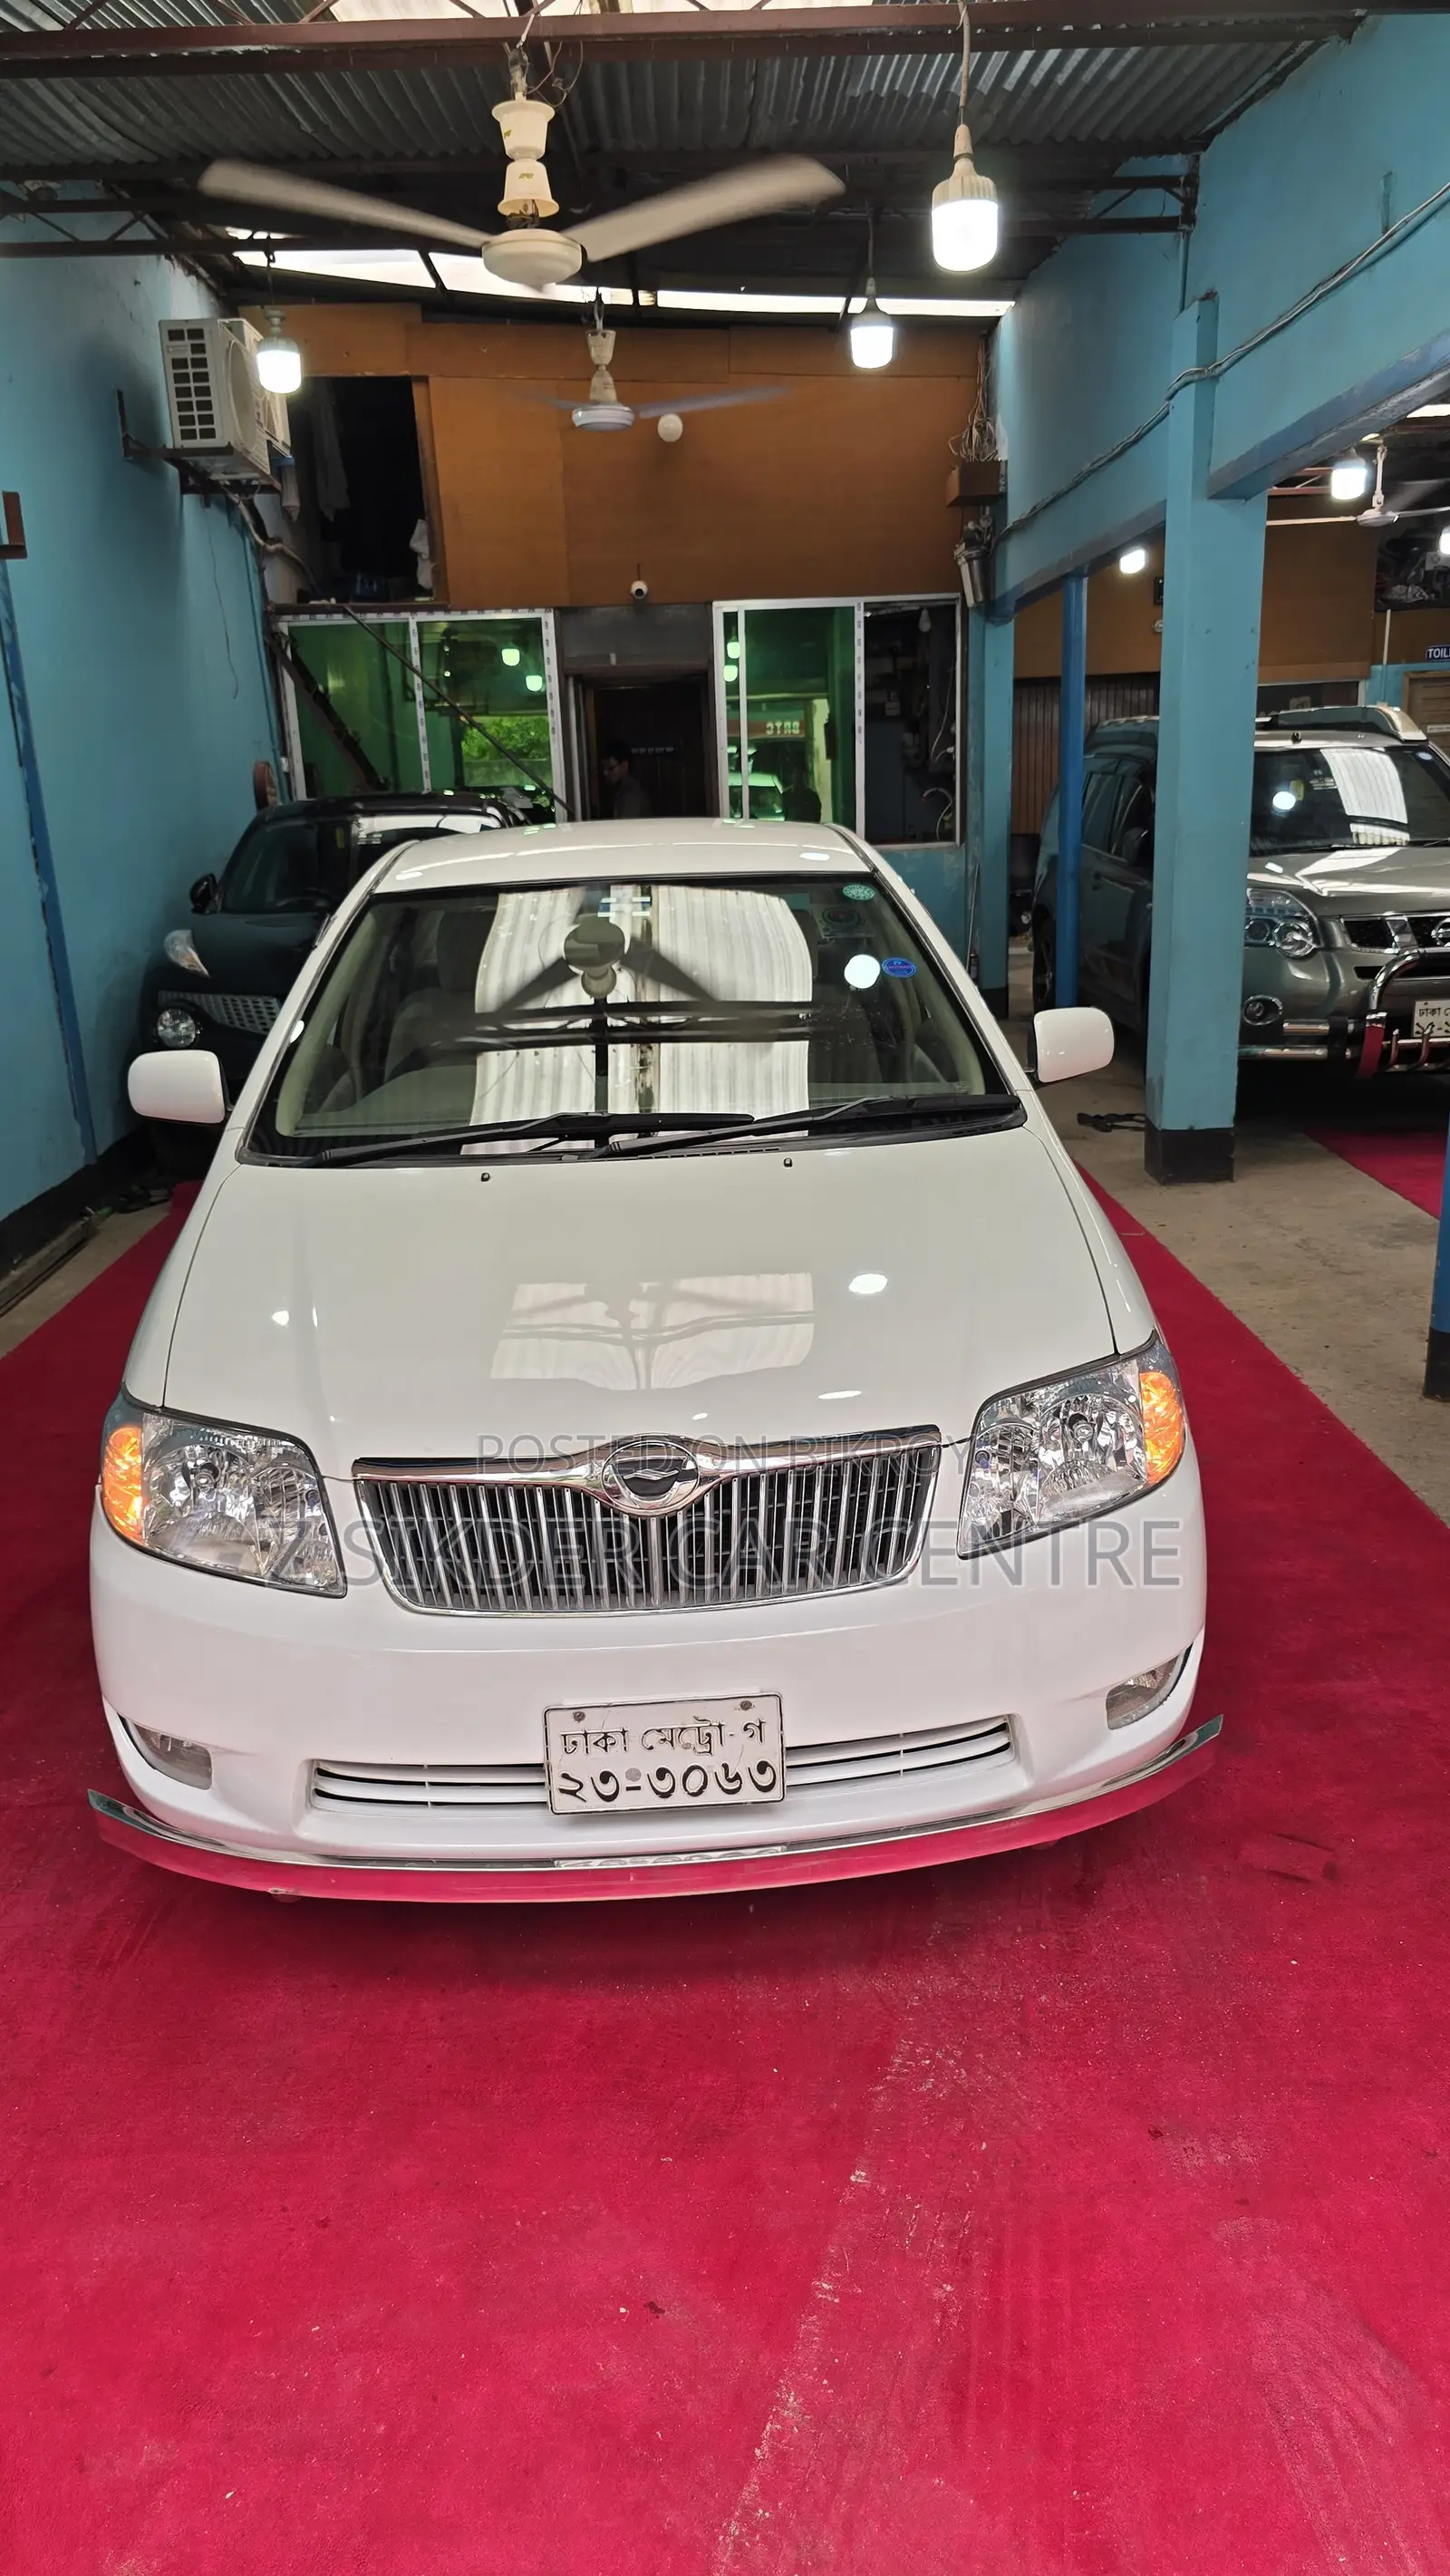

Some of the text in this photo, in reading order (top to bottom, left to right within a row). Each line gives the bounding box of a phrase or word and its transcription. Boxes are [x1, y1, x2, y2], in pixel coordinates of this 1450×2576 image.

[1428, 647, 1450, 659] TOIL
[560, 1728, 629, 1756] ঢাকা
[558, 1760, 777, 1803] ২৩-৩০৬৩
